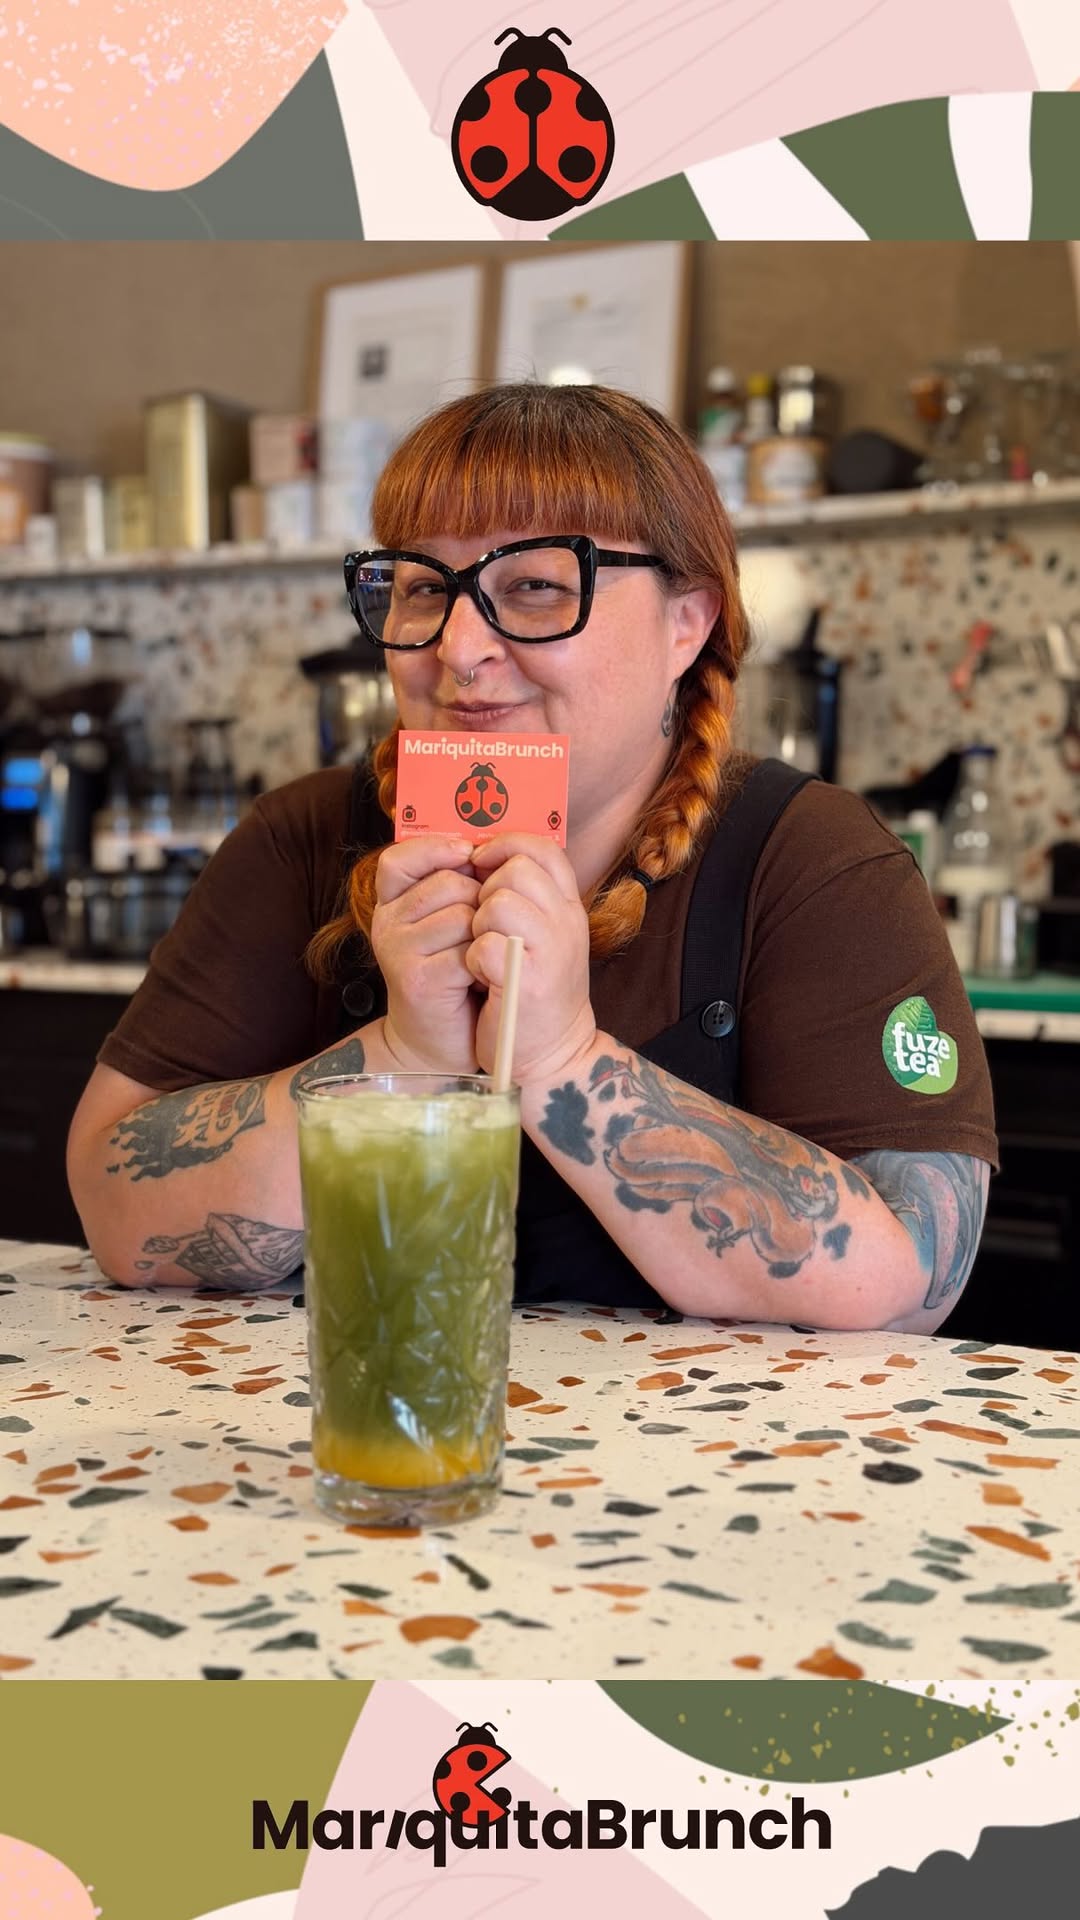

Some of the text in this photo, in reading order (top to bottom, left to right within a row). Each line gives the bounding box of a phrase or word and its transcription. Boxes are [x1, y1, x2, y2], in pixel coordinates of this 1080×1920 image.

[404, 738, 564, 760] MariquitaBrunch
[892, 1022, 951, 1060] fuze
[893, 1050, 941, 1078] tea
